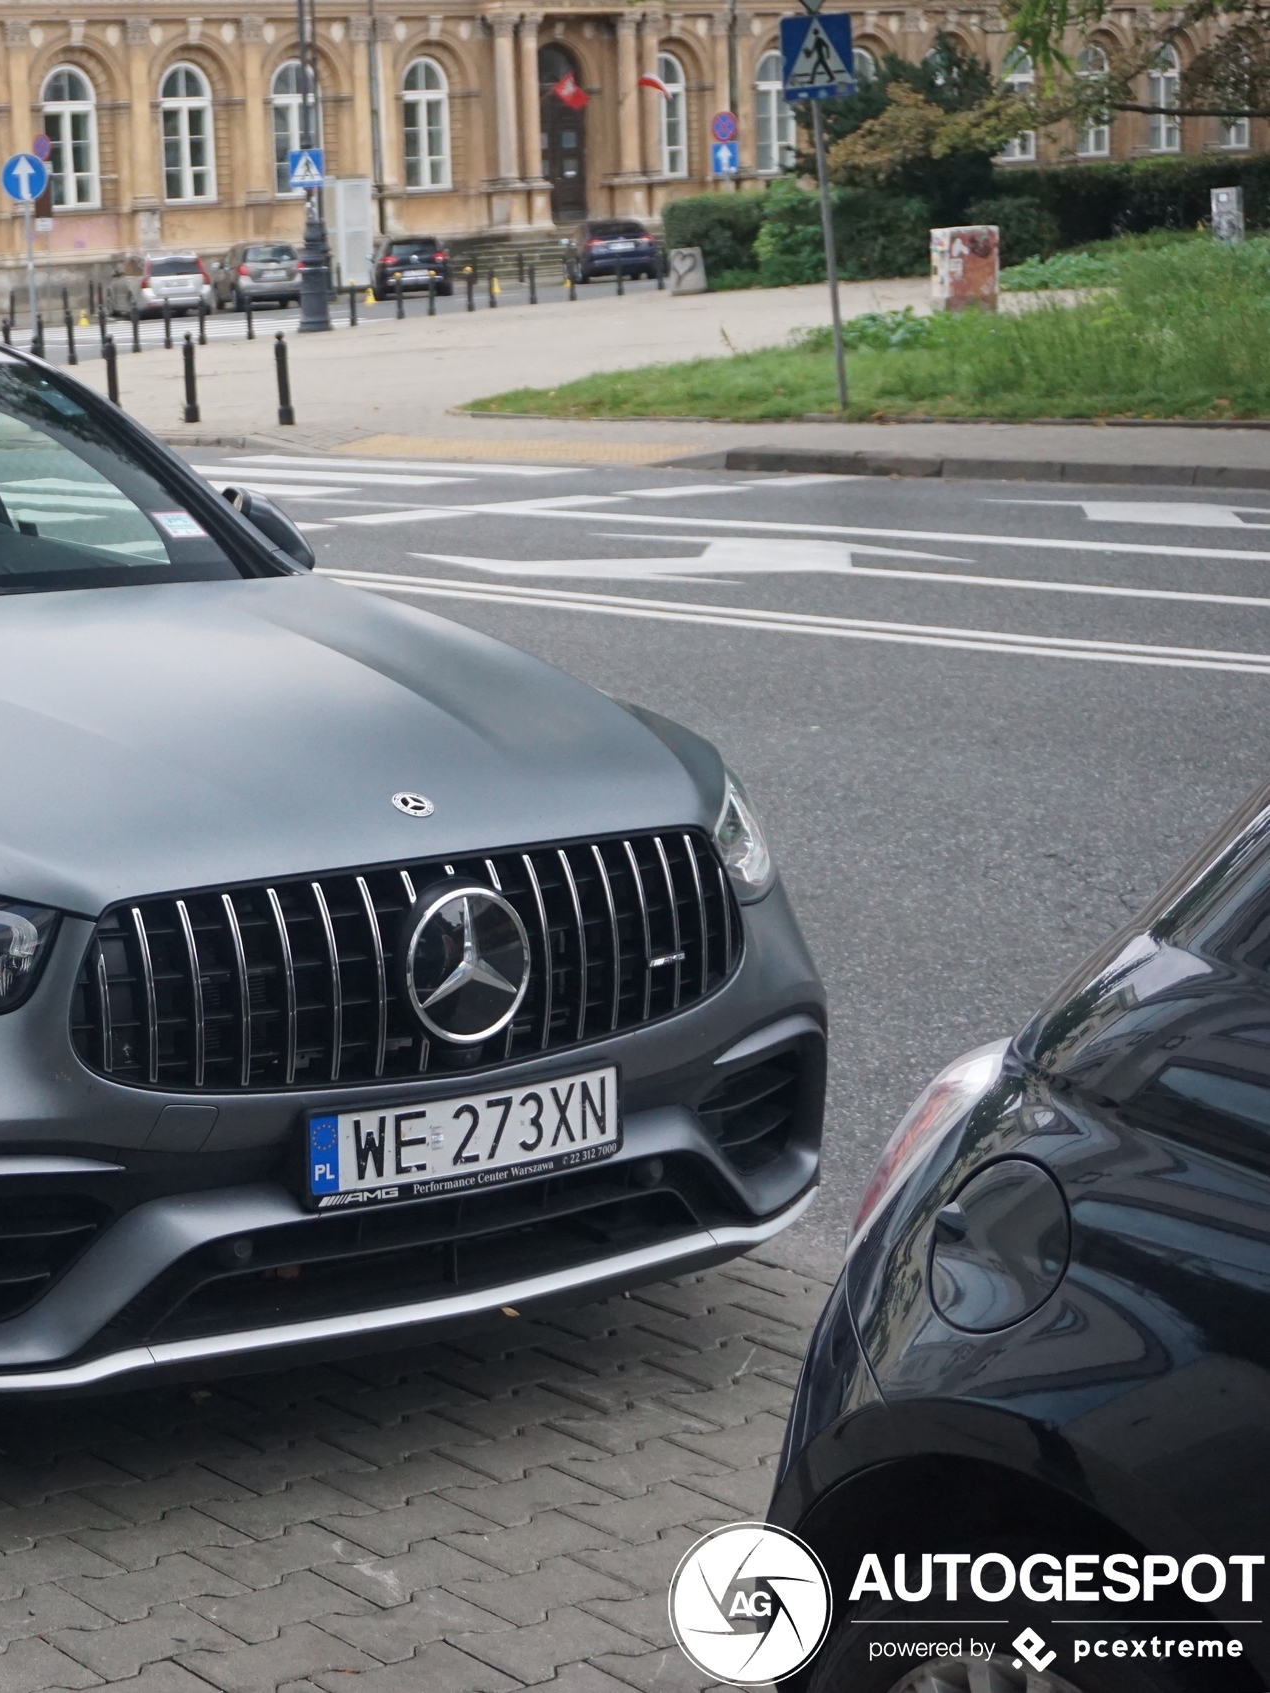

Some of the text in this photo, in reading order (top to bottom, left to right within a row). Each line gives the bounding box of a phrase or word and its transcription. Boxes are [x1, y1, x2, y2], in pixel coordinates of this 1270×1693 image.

[352, 1075, 607, 1181] WE 273XN
[314, 1163, 336, 1182] PL
[412, 1175, 476, 1196] Performance
[477, 1170, 509, 1185] Center
[510, 1160, 555, 1178] Warszawa
[569, 1153, 581, 1164] 22
[582, 1149, 596, 1161] 312
[597, 1142, 618, 1157] 7000
